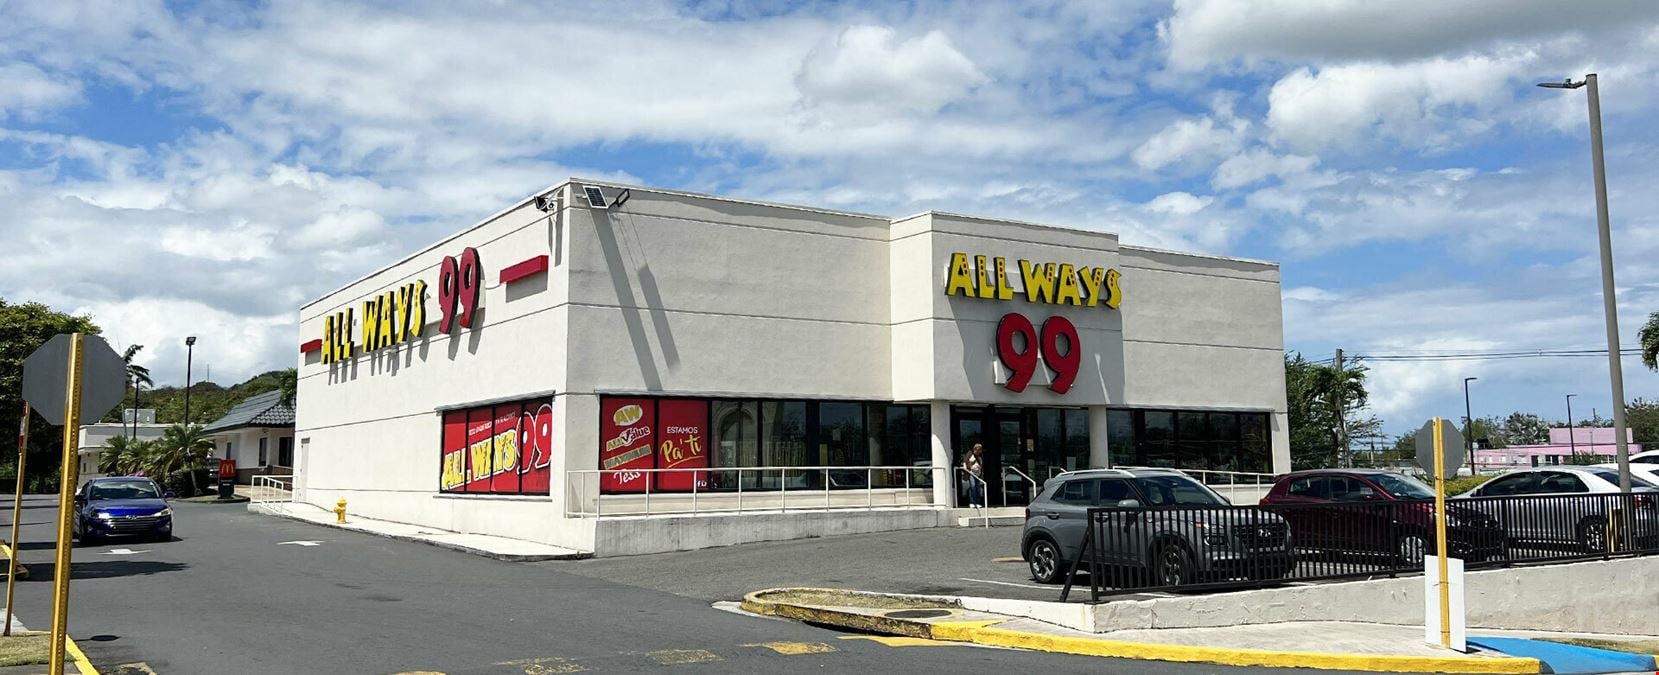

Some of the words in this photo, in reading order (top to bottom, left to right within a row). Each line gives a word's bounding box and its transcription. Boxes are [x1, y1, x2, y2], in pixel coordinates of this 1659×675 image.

[945, 252, 1013, 300] ALL
[1018, 259, 1121, 309] WAYS
[321, 308, 354, 364] ALL
[363, 279, 427, 353] WAYS
[439, 247, 481, 334] 99
[997, 312, 1080, 394] 99
[667, 426, 698, 434] ESTAMOS
[441, 448, 471, 490] ALL
[613, 468, 641, 484] Tess
